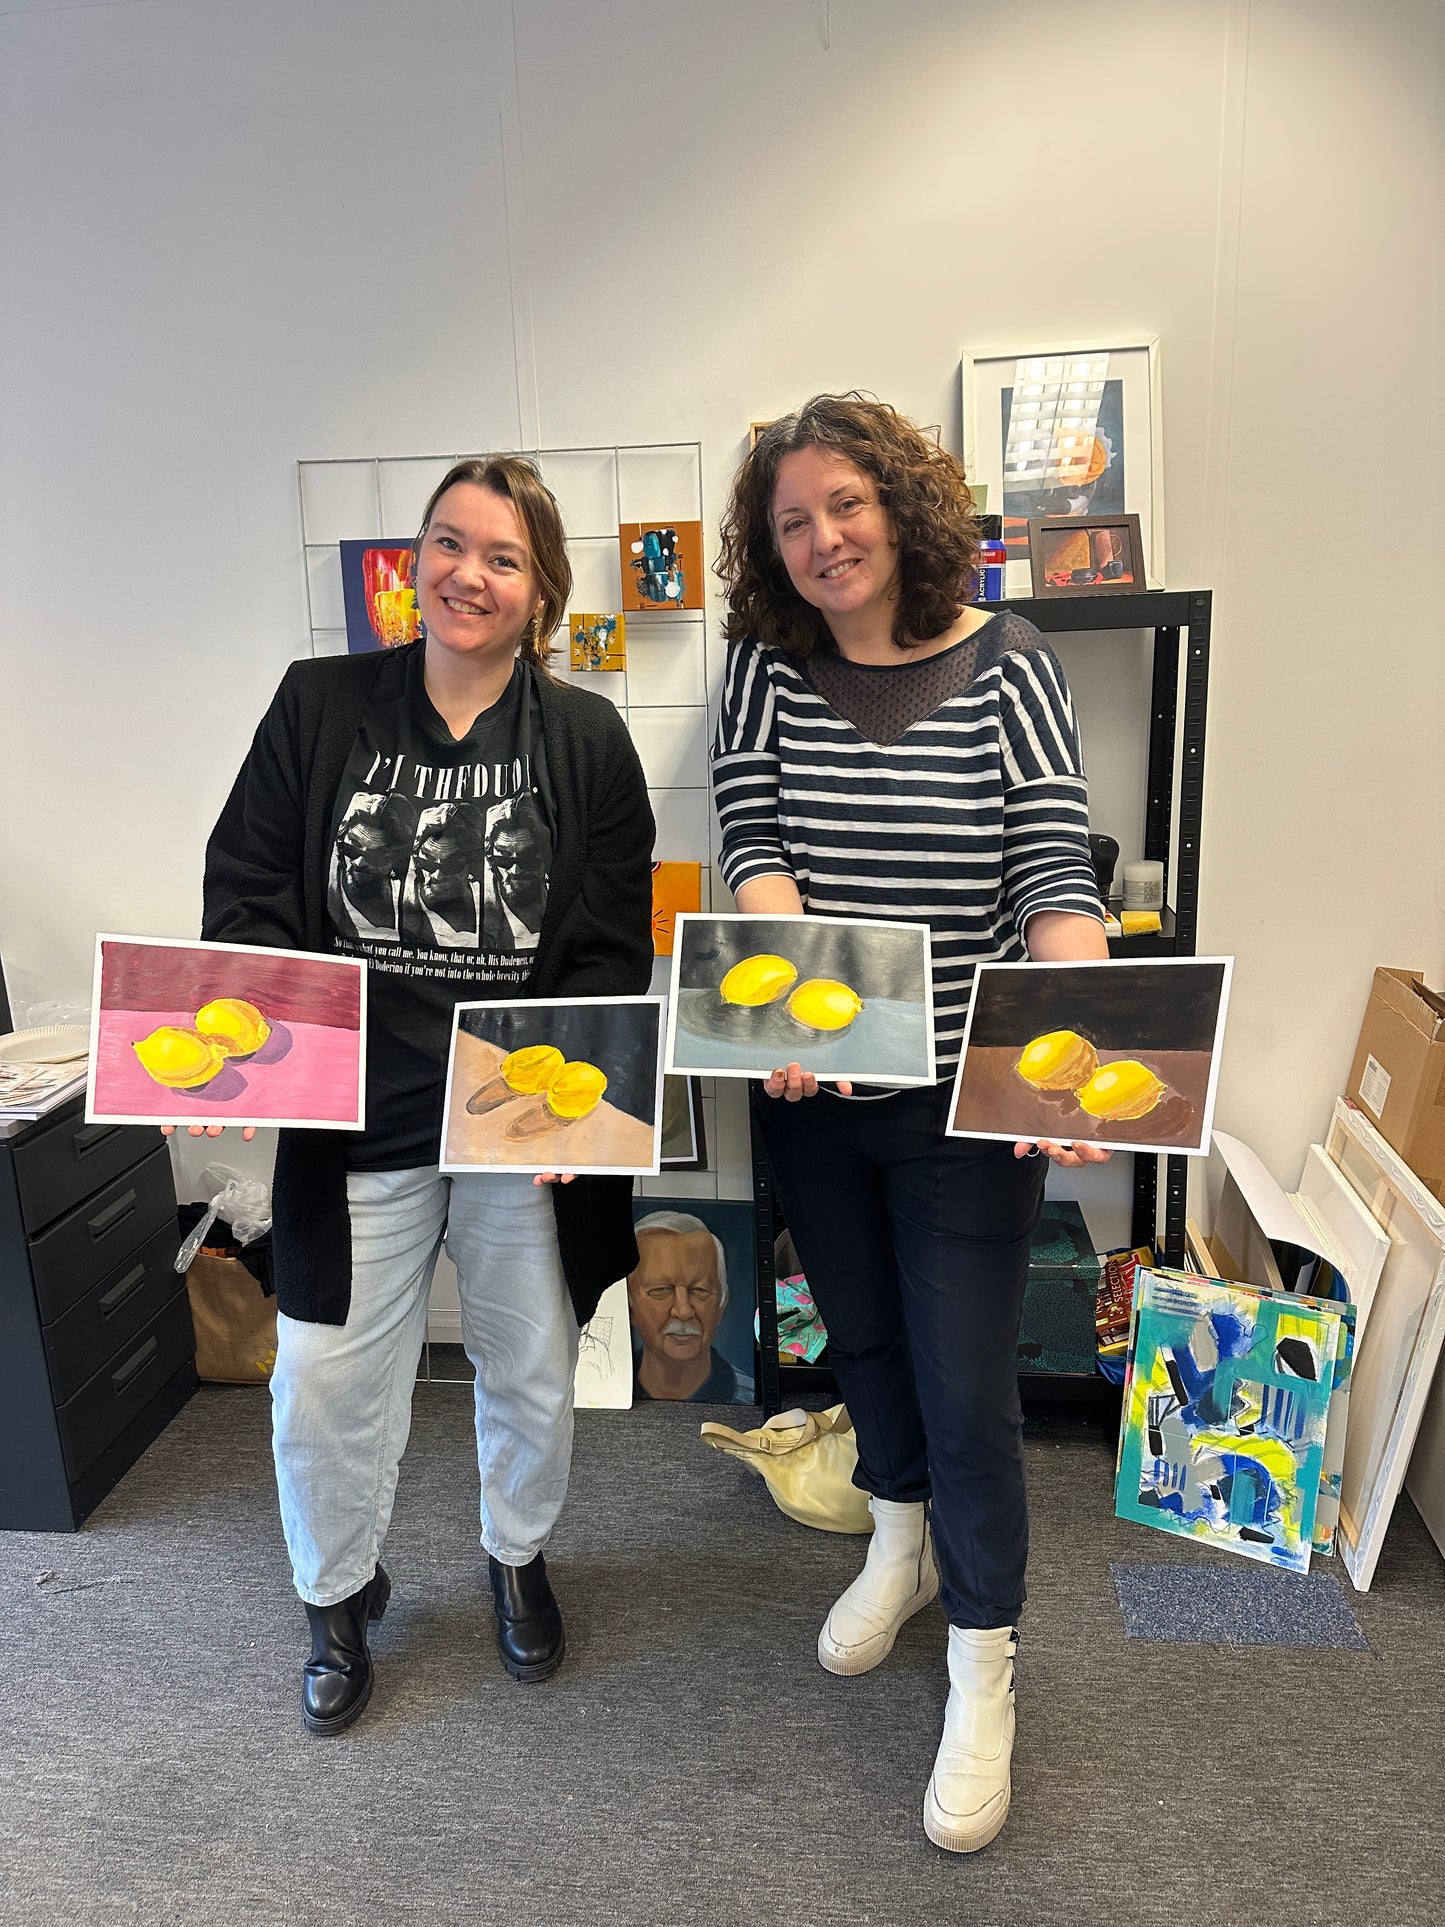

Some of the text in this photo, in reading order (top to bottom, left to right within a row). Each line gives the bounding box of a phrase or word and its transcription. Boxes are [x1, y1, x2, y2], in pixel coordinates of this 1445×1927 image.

[374, 946, 387, 958] you
[388, 947, 402, 957] call
[402, 949, 415, 959] me.
[417, 948, 428, 960] You
[429, 949, 449, 963] know,
[450, 951, 465, 964] that
[466, 955, 475, 966] or,
[476, 953, 487, 966] uh,
[488, 954, 499, 966] His
[375, 959, 403, 974] Duderino
[404, 962, 411, 975] if
[410, 964, 433, 977] you're
[434, 967, 446, 978] not
[447, 967, 462, 979] into
[462, 968, 474, 980] the
[475, 969, 496, 981] whole
[496, 970, 520, 984] brevity
[1108, 1260, 1124, 1303] SELECTION
